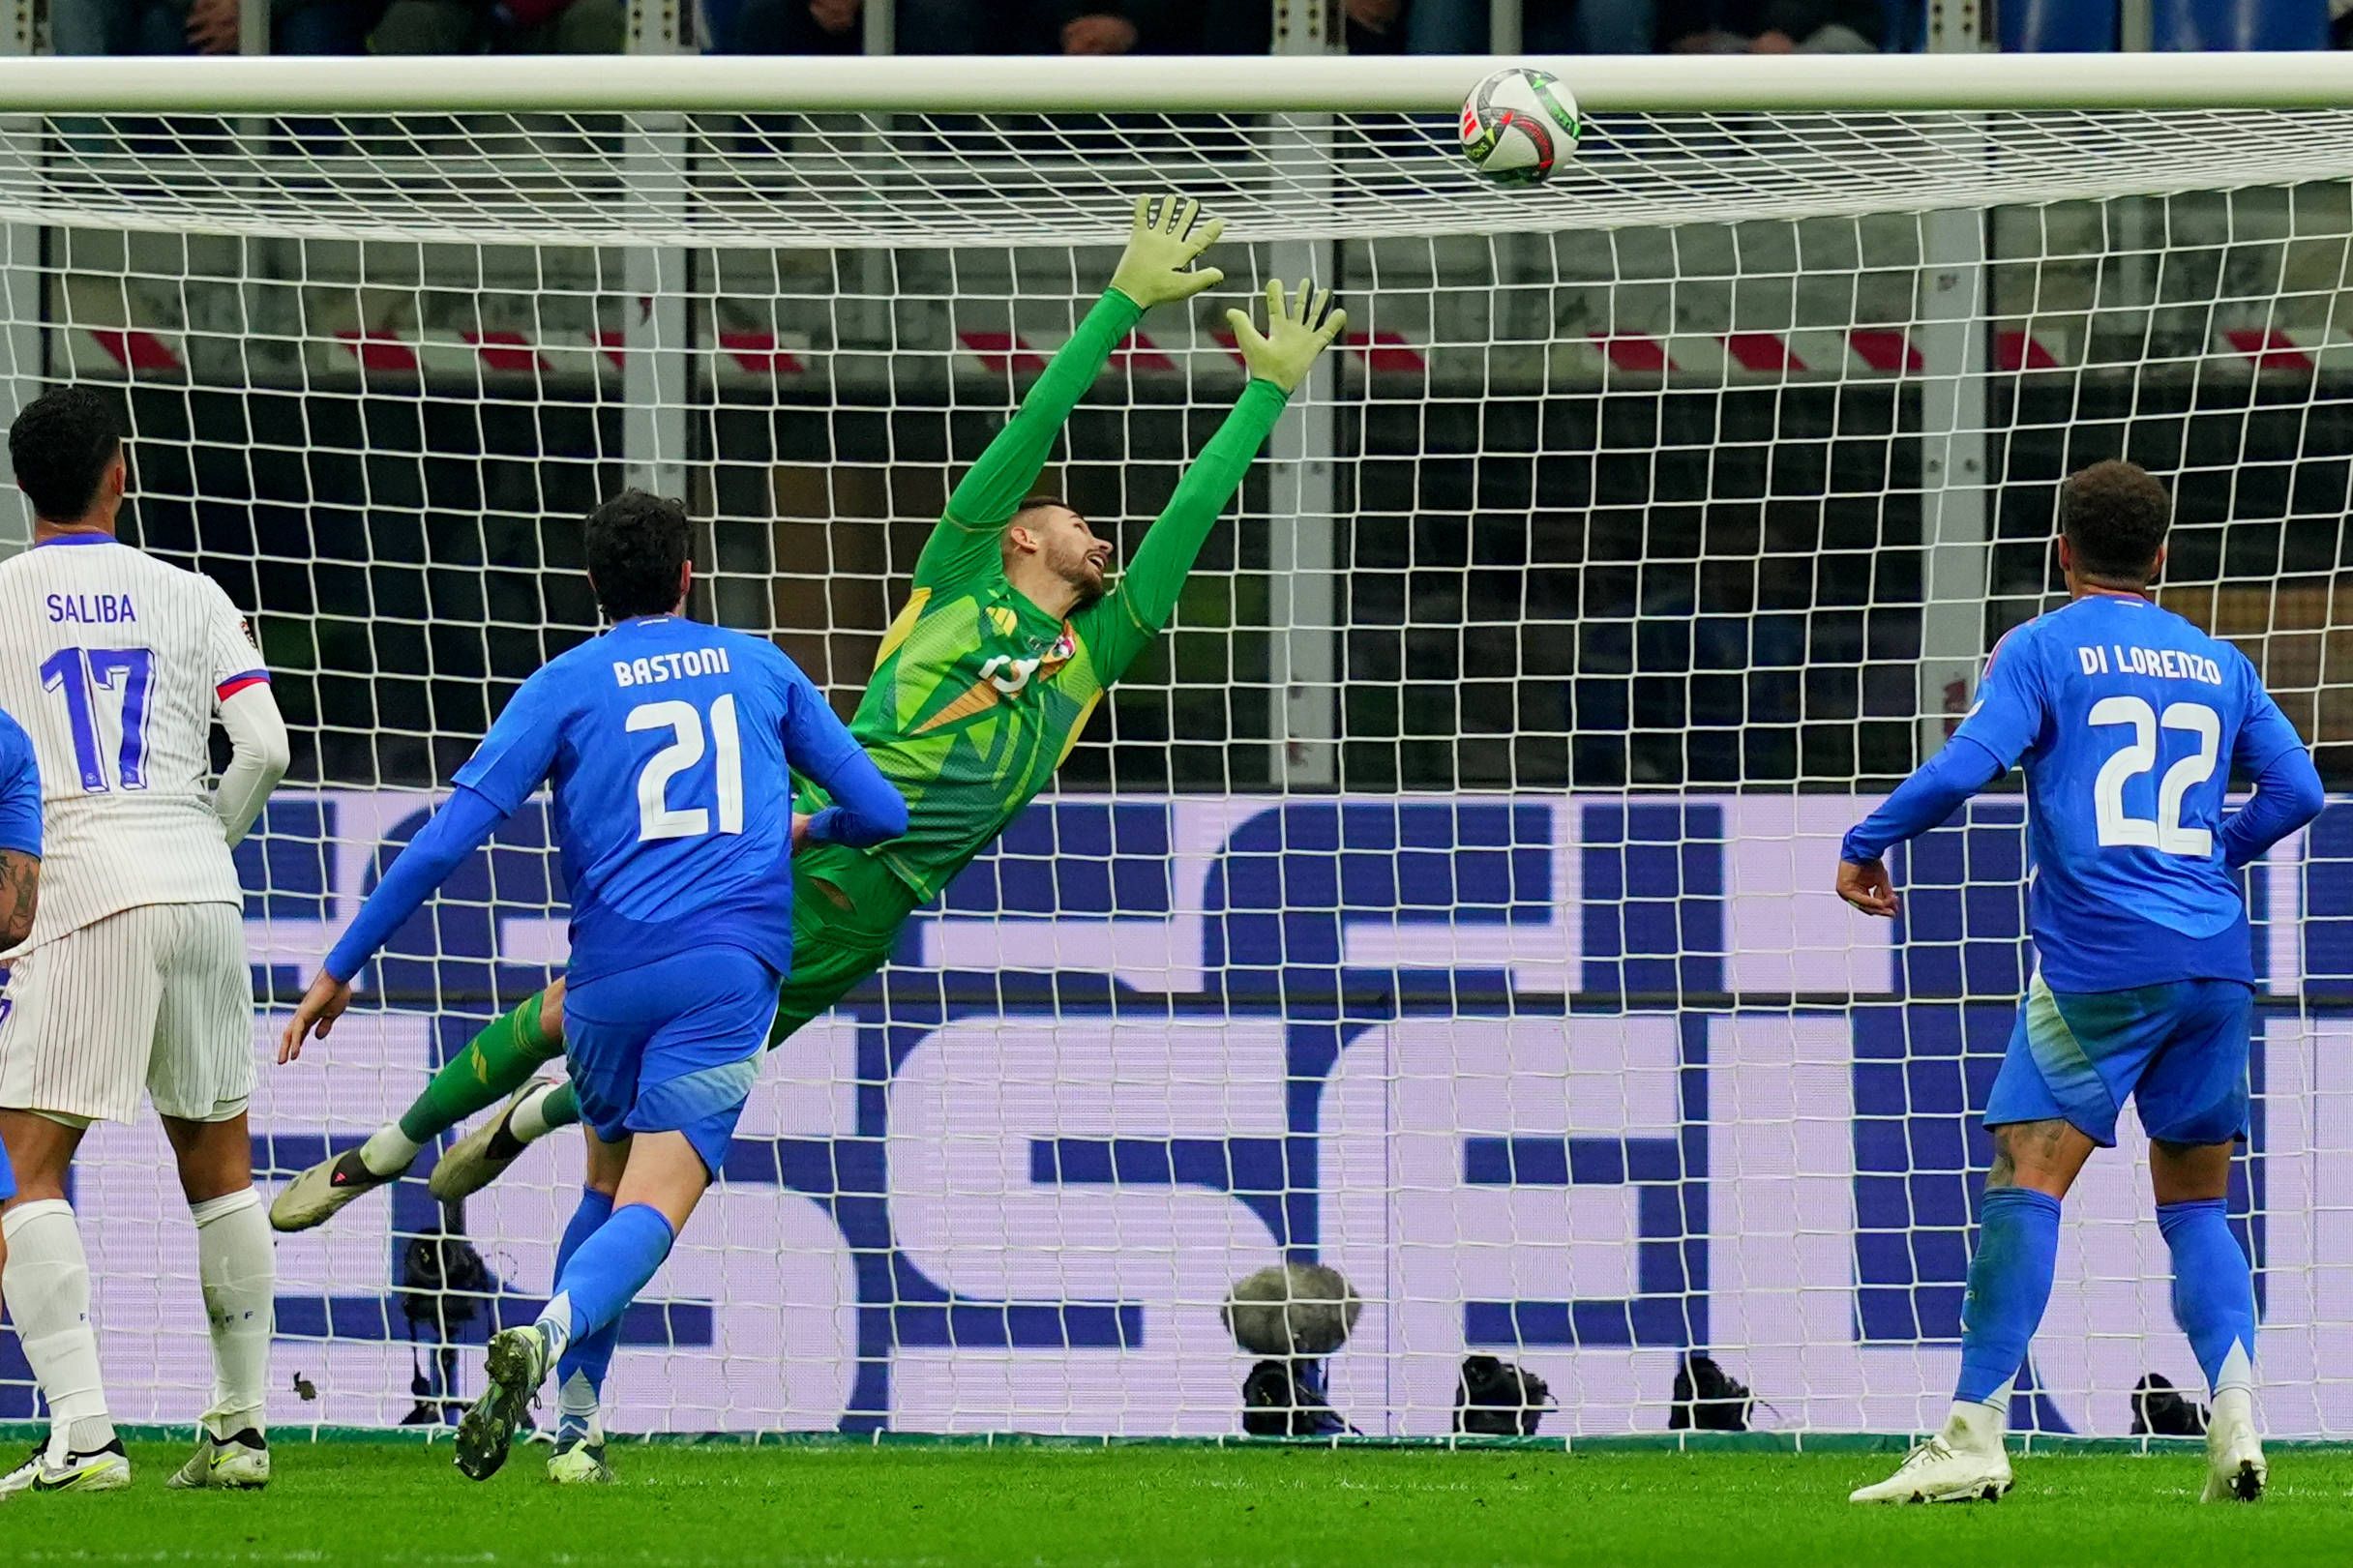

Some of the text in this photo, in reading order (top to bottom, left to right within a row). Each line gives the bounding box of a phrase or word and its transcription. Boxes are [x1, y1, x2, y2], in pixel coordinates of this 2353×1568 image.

[46, 593, 136, 624] SALIBA
[612, 646, 730, 688] BASTONI
[2078, 644, 2222, 686] DI LORENZO
[39, 645, 157, 794] 17
[625, 693, 744, 843] 21
[2087, 695, 2221, 858] 22
